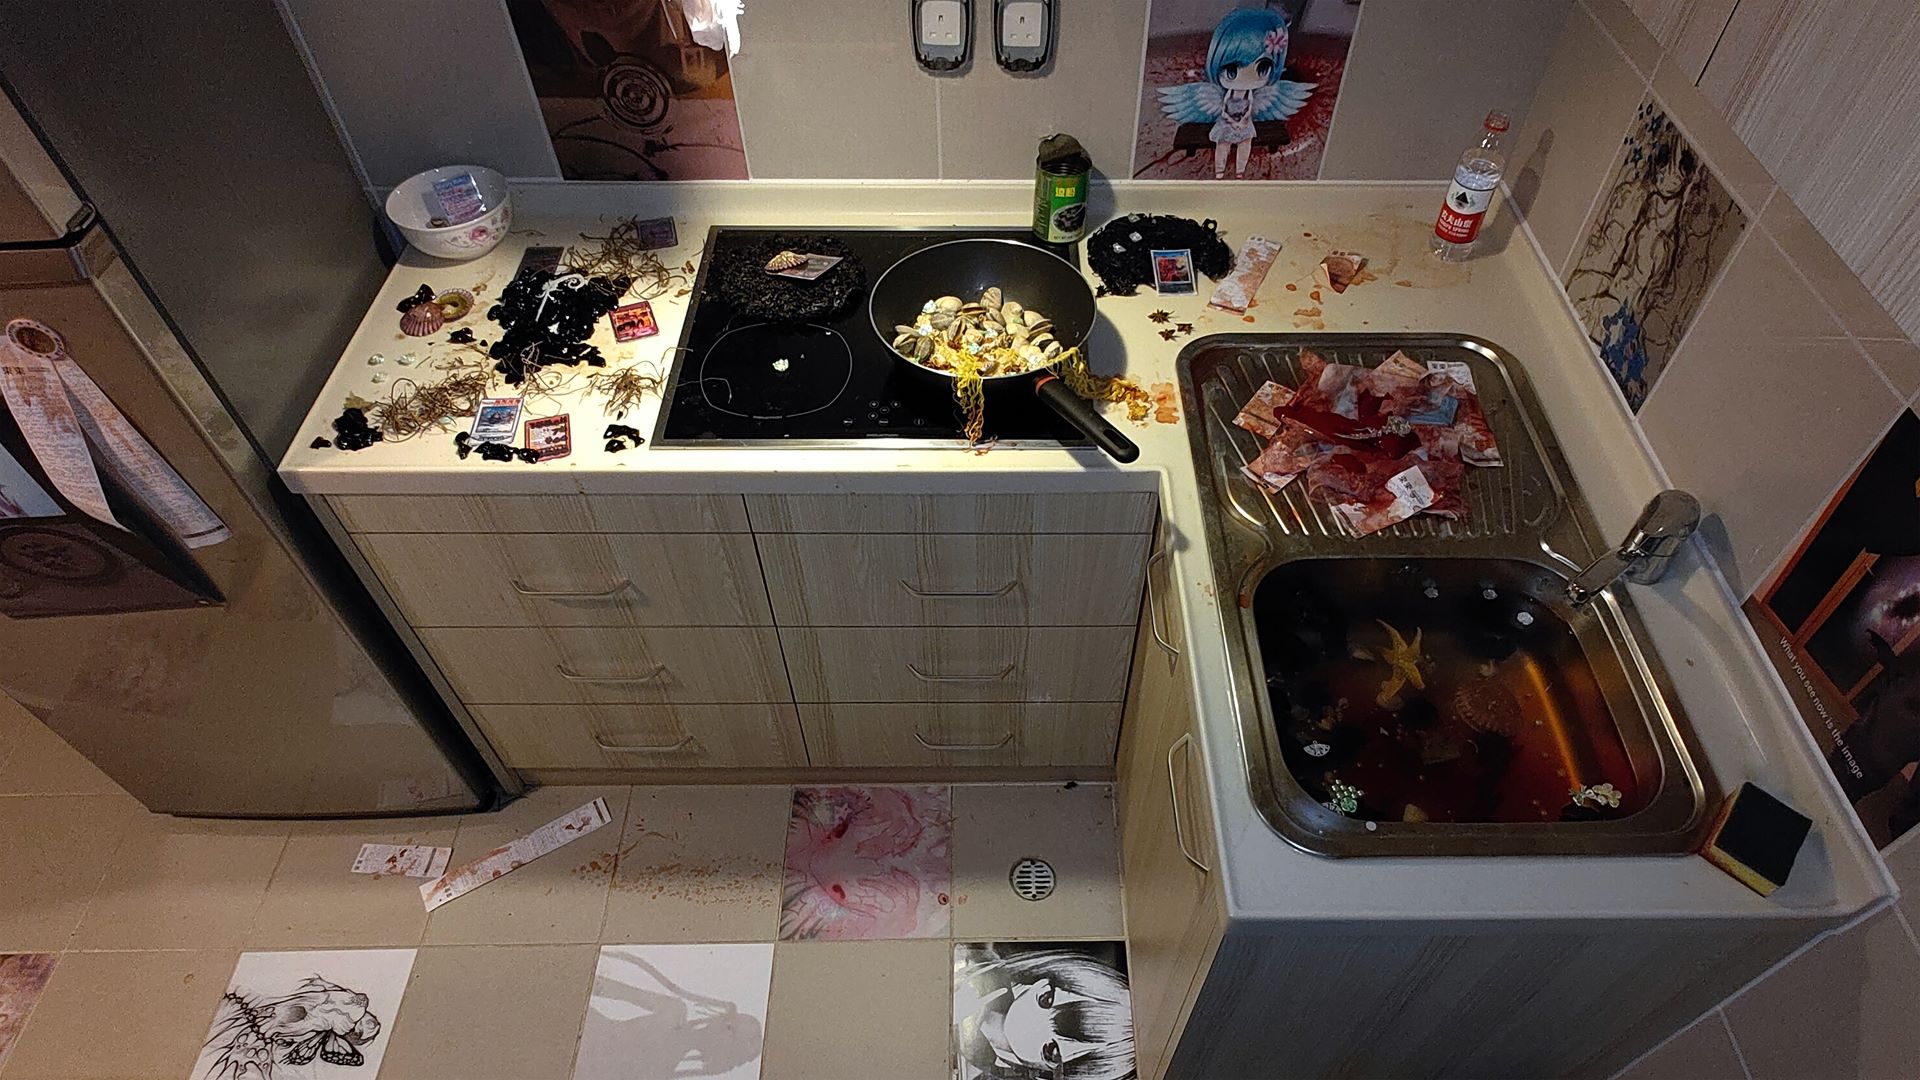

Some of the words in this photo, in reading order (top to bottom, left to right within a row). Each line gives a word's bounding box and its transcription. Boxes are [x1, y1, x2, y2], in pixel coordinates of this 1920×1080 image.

[1780, 636, 1796, 662] What
[1792, 661, 1806, 680] you
[1804, 680, 1816, 697] see
[1812, 697, 1829, 718] now
[1825, 717, 1834, 731] is
[1831, 729, 1844, 747] the
[1841, 746, 1864, 779] image
